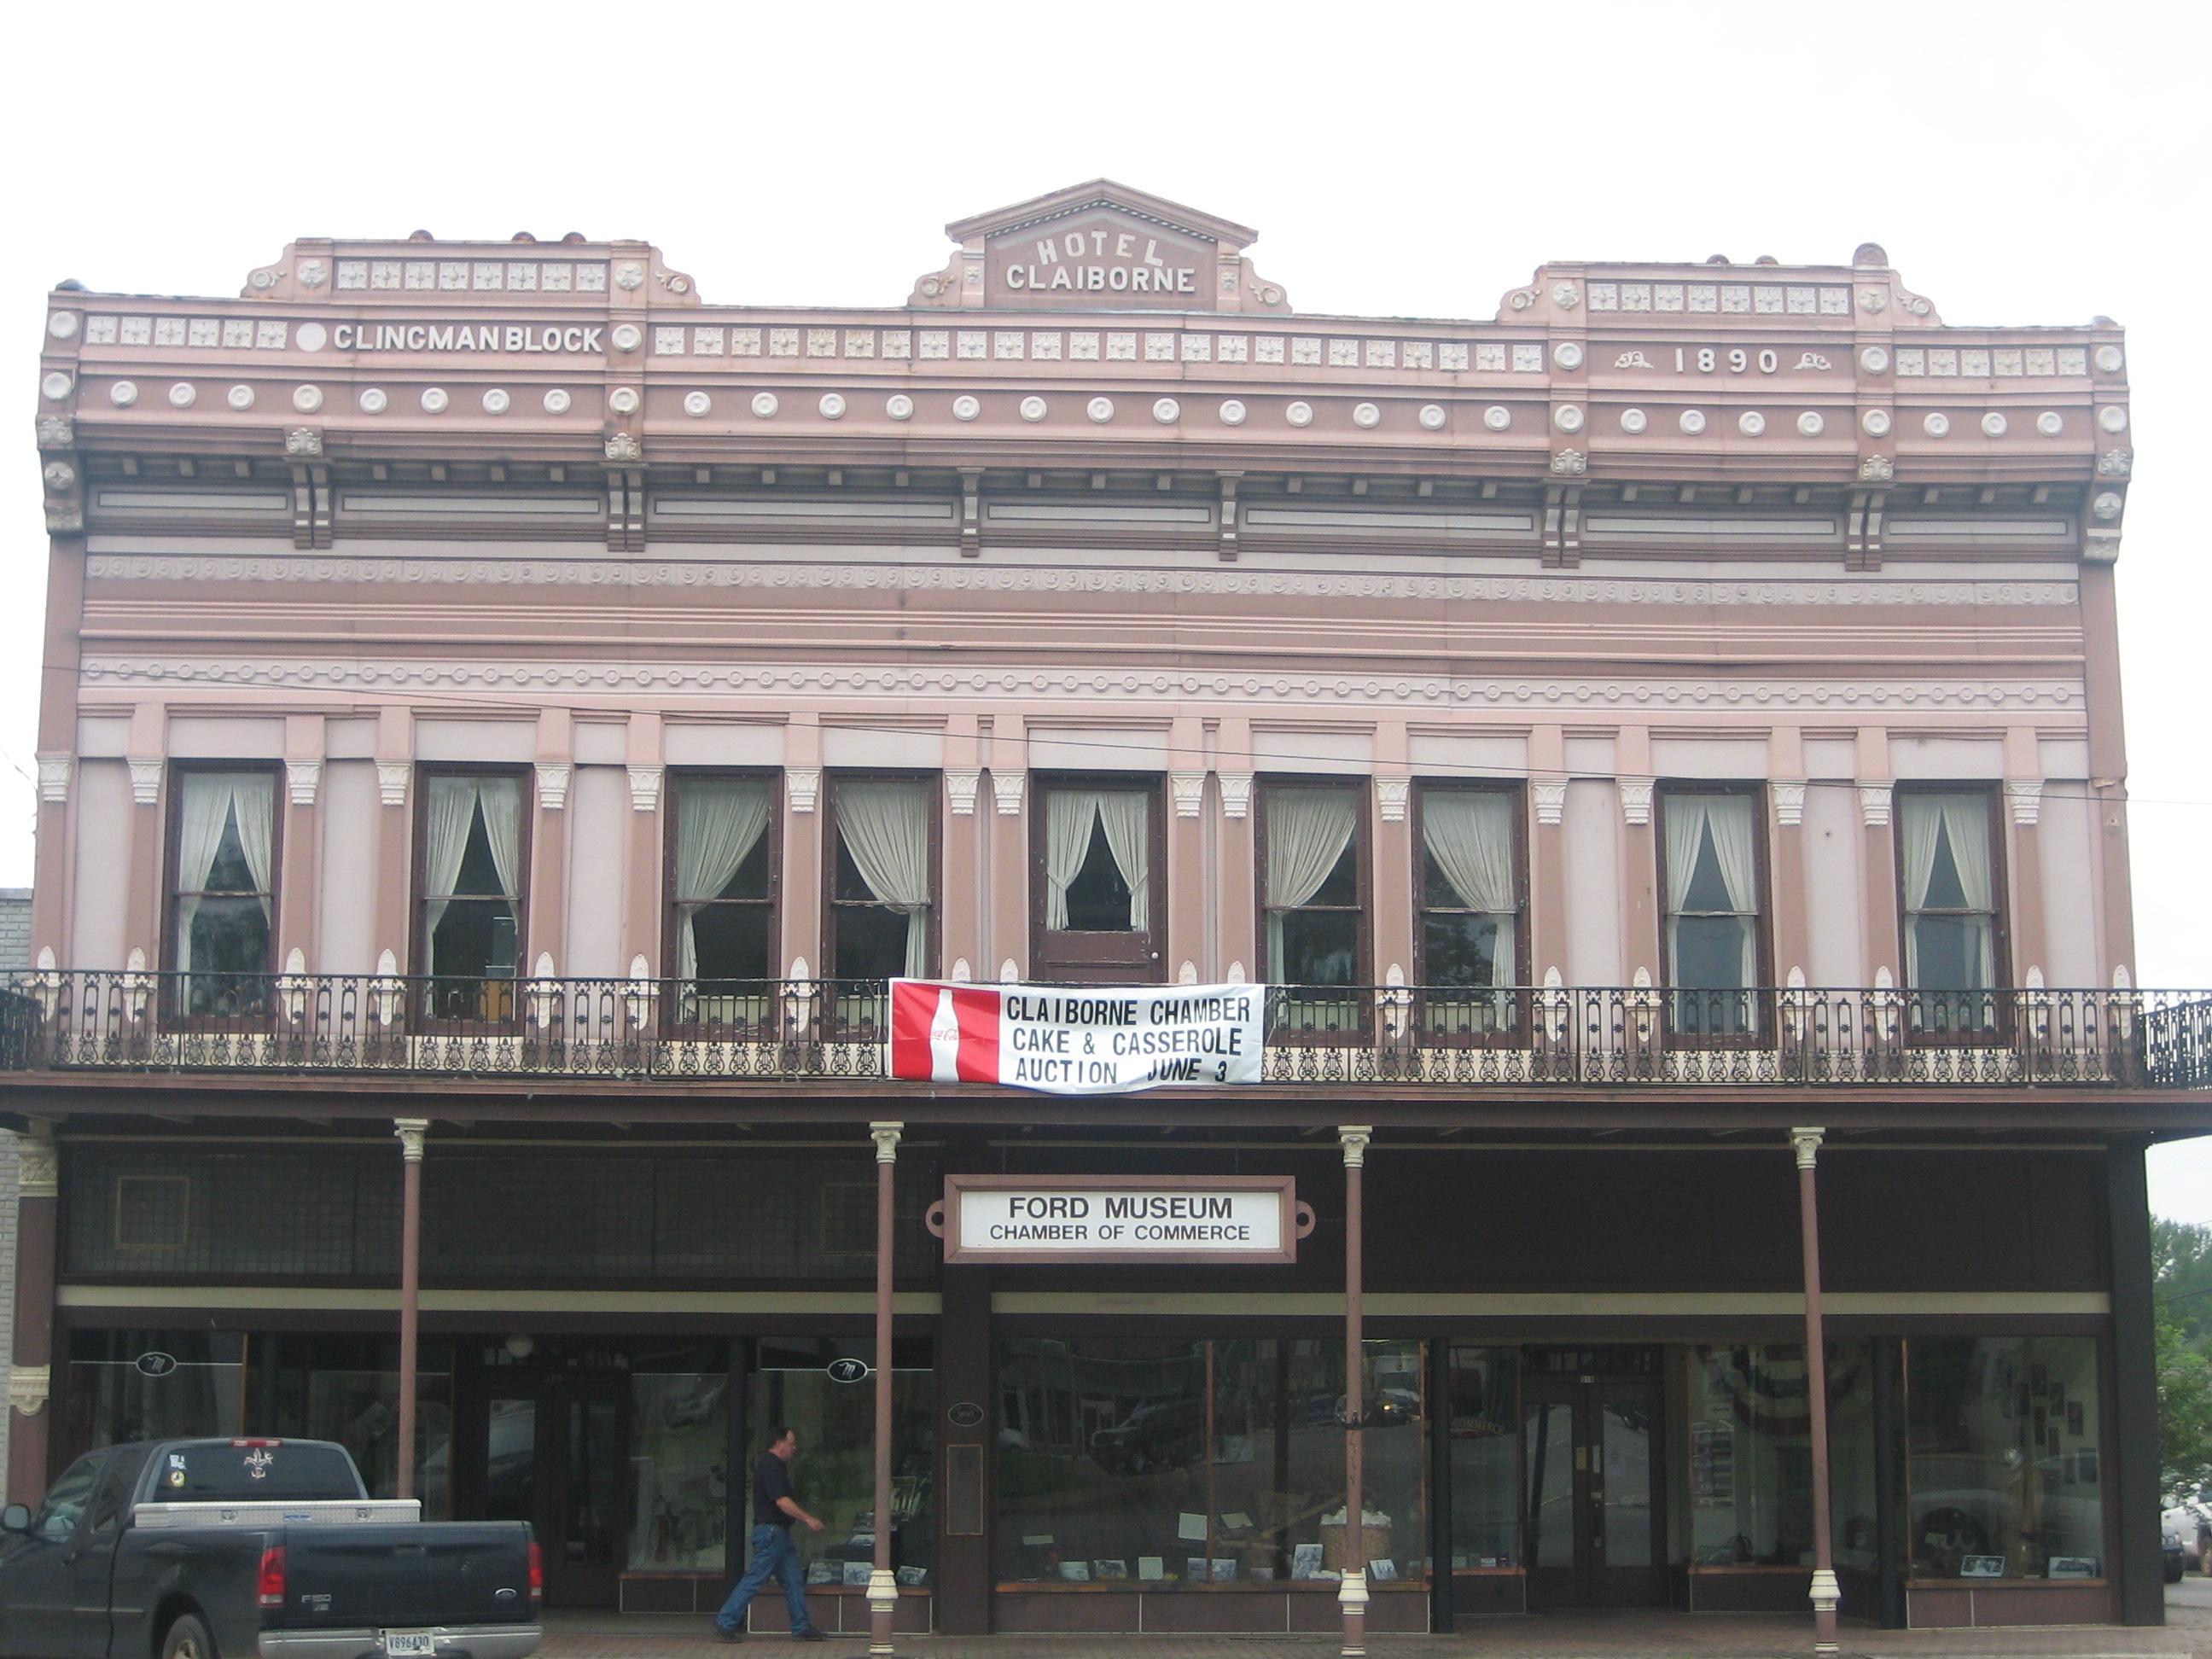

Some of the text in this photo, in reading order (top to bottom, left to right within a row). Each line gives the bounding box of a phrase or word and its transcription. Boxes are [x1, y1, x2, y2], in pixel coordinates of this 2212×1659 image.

[1037, 230, 1163, 267] HOTEL
[1006, 265, 1196, 292] CLAIBORNE
[334, 324, 603, 352] CLINGMAN BLOCK
[1674, 347, 1778, 373] 1890
[1007, 996, 1251, 1025] CLAIBORNE CHAMBER
[1012, 1027, 1243, 1057] CAKE & CASSEROLE
[1016, 1057, 1228, 1084] AUCTION JUNE 3
[1010, 1196, 1232, 1219] FORD MUSEUM
[990, 1225, 1250, 1241] CHAMBER OF COMMERCE
